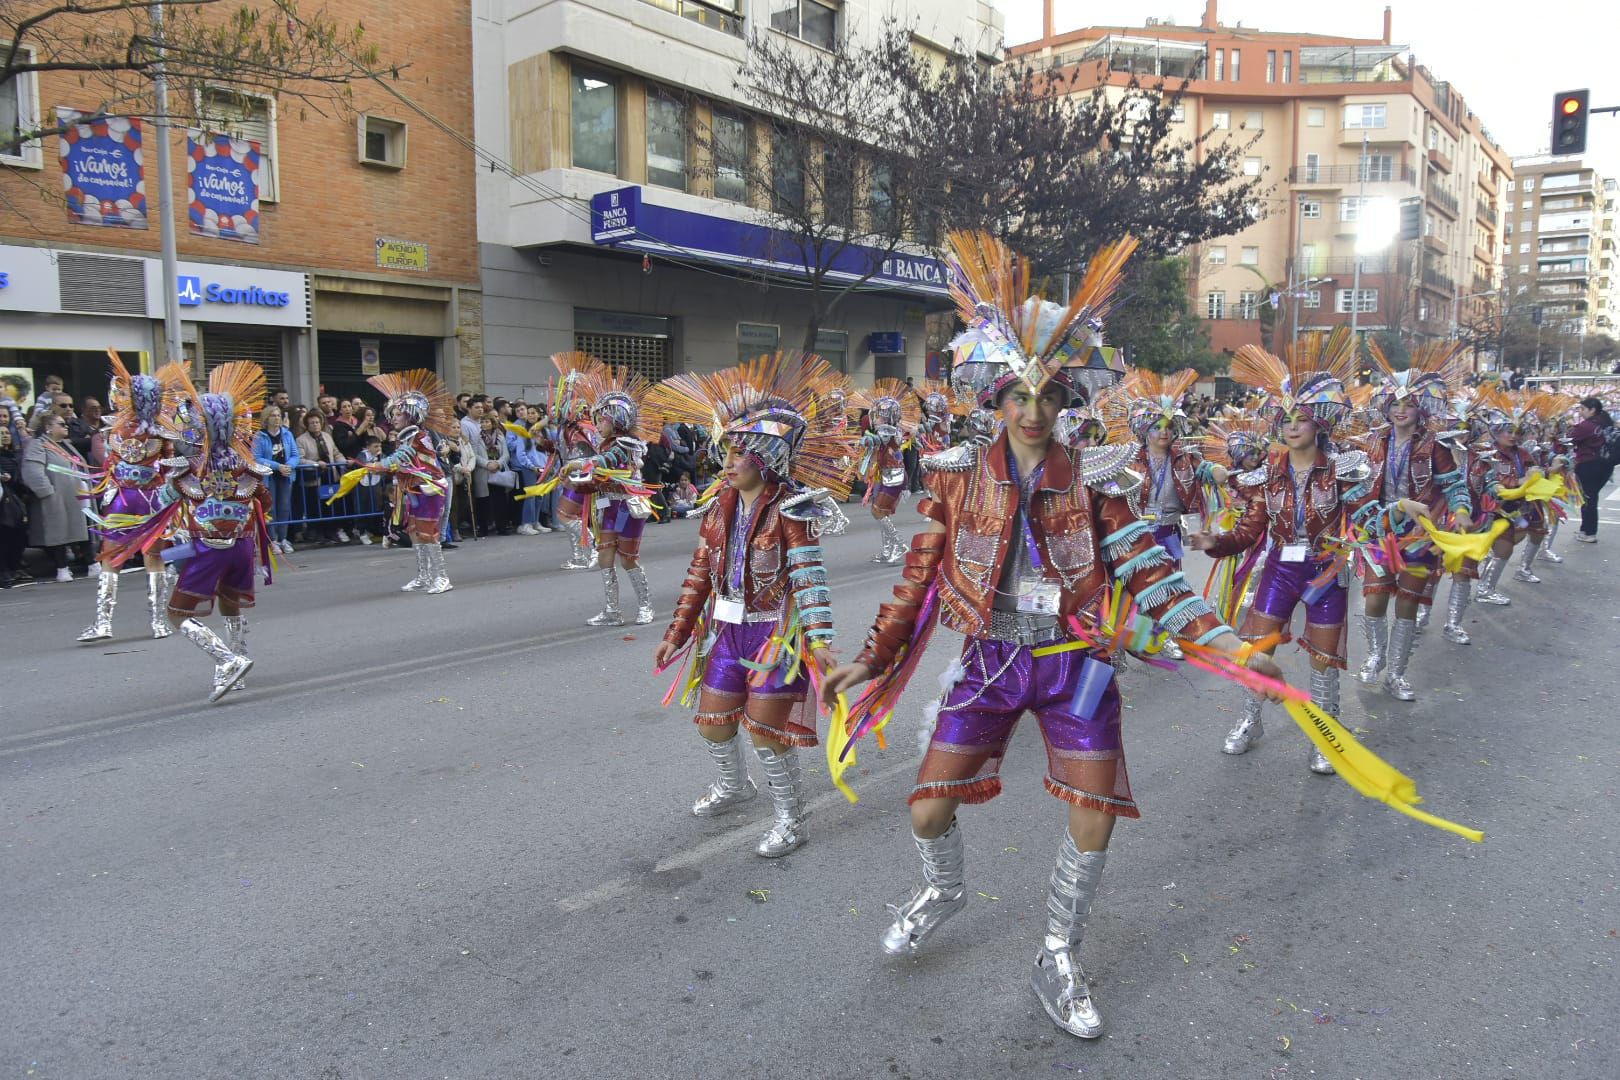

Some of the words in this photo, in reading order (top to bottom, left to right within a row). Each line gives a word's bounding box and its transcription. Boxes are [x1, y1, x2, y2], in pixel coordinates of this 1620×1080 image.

[73, 155, 128, 179] ¡Vamos
[89, 176, 133, 187] carnaval!
[198, 172, 245, 196] ¡Vamos
[210, 192, 248, 205] carnaval!
[603, 207, 627, 220] BANCA
[387, 244, 417, 254] AVENIDA
[387, 256, 417, 266] EUROPA
[895, 259, 942, 284] BANCA
[206, 283, 290, 308] Sanitas
